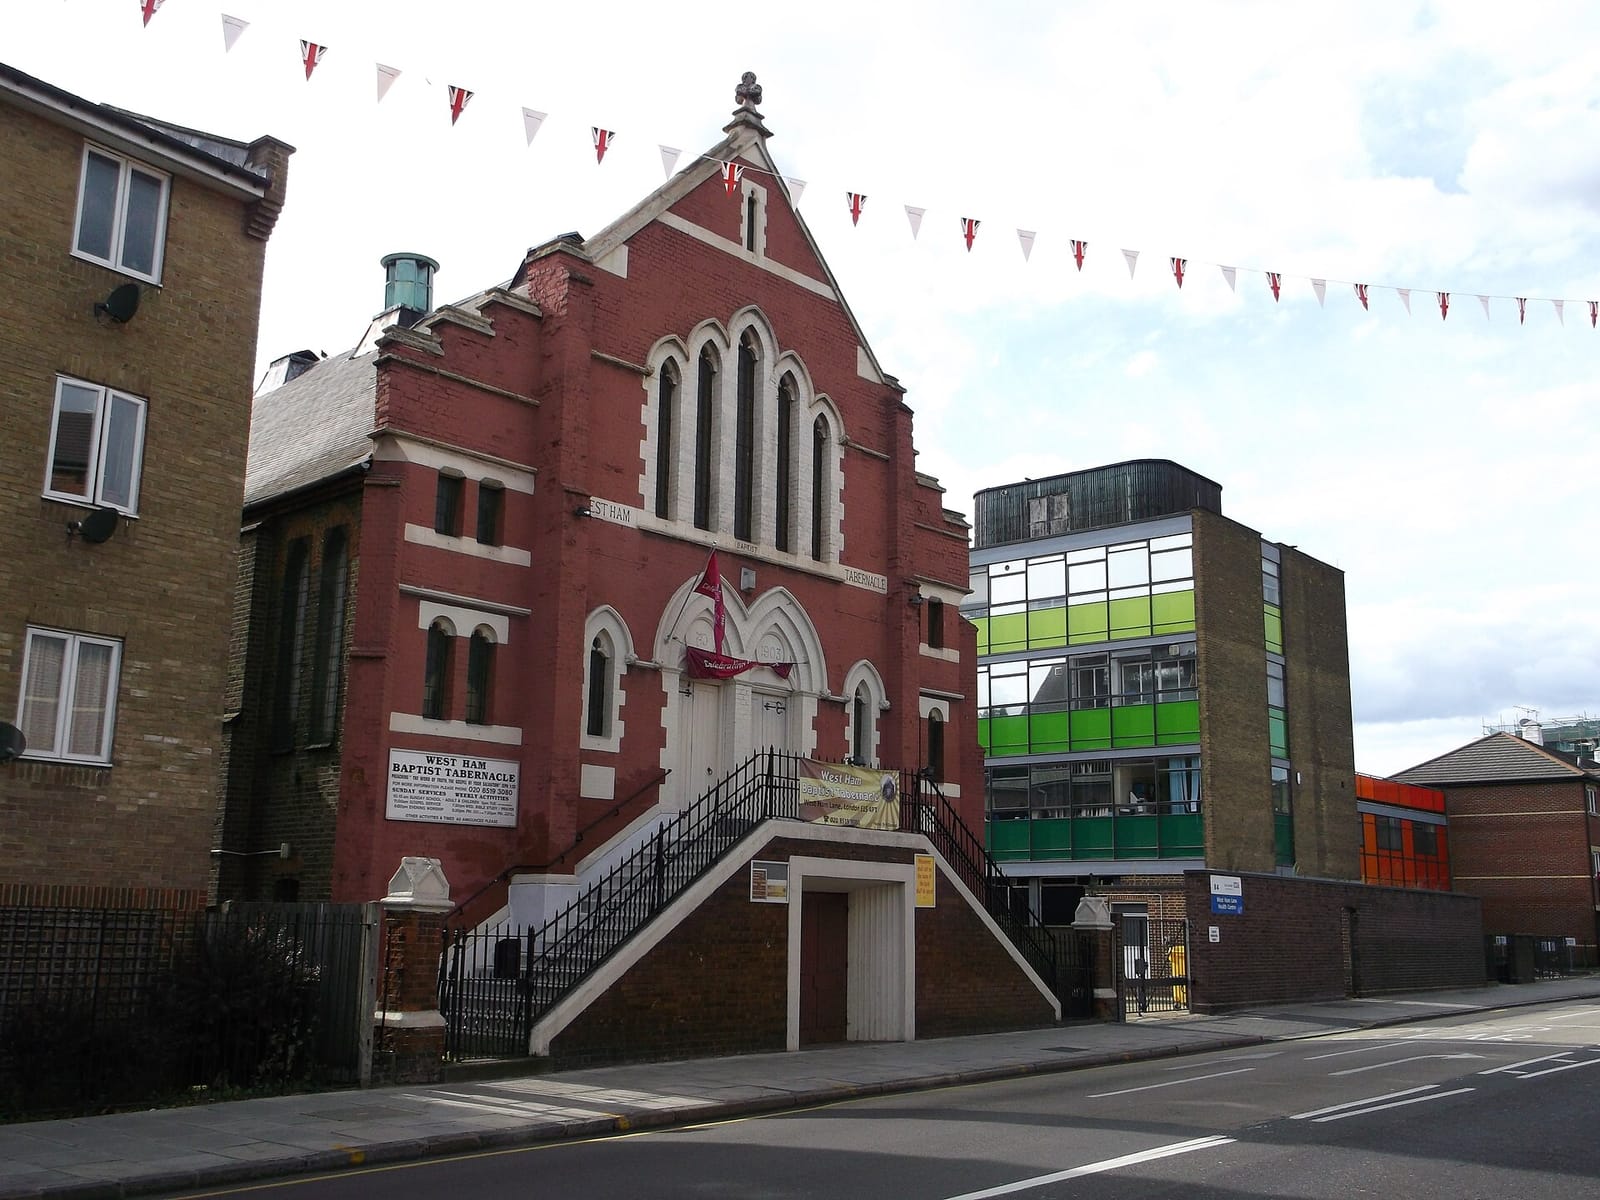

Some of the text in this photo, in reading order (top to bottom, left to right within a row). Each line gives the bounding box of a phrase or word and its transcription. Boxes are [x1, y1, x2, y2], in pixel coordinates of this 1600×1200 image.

[590, 500, 630, 522] EST HAM
[844, 569, 886, 590] TABERNACLE
[425, 755, 486, 769] WEST HAM
[392, 763, 515, 782] BAPTIST TABERNACLE
[821, 770, 862, 786] West Ham
[802, 782, 834, 797] Baptist
